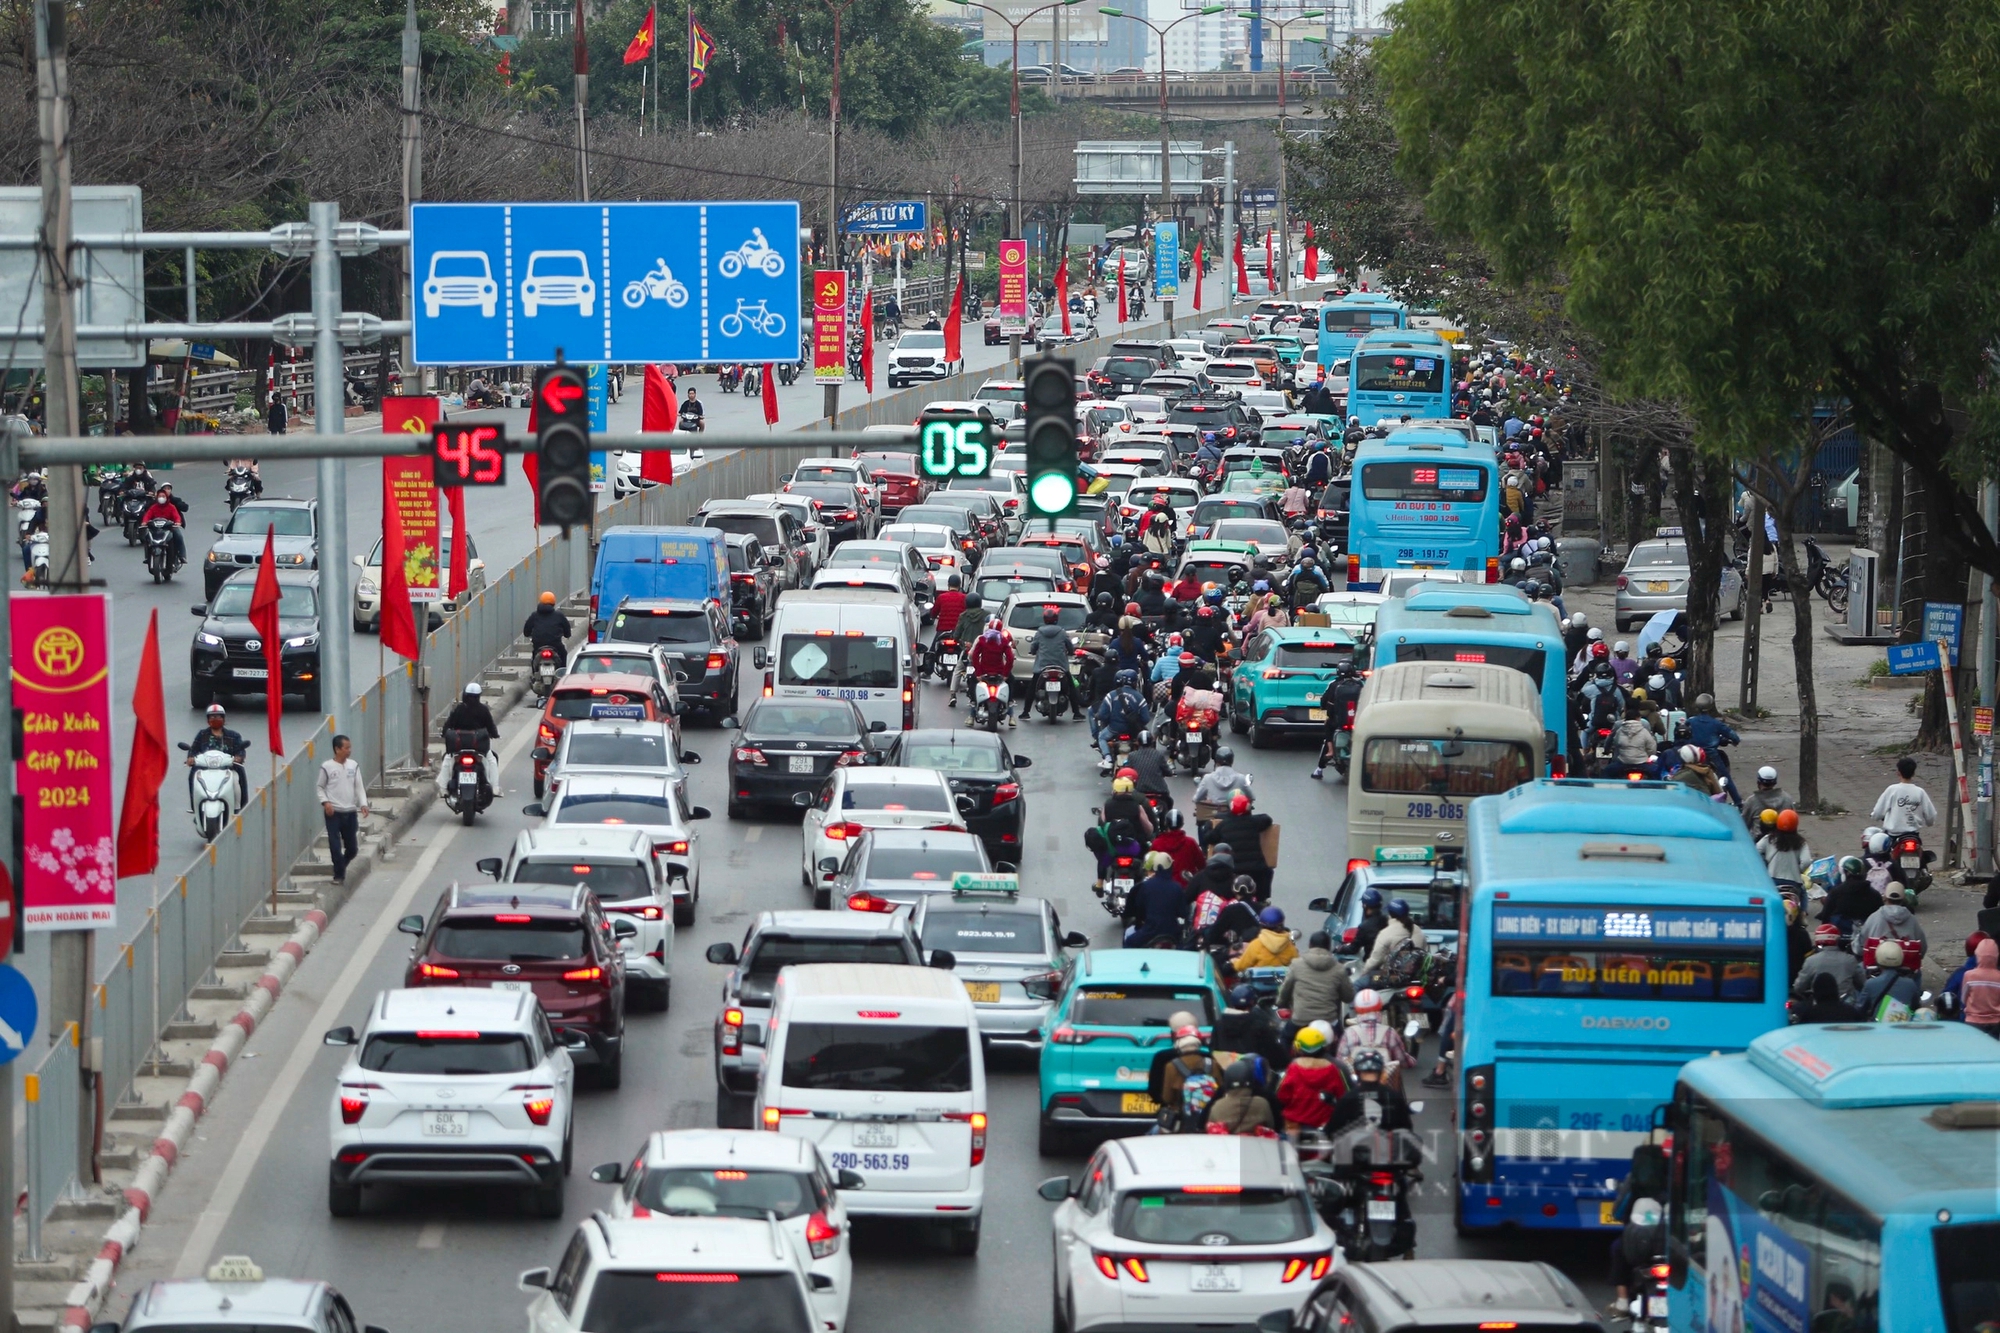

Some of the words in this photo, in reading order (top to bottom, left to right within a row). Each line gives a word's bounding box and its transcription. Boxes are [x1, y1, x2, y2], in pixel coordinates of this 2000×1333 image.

[899, 204, 915, 221] KỲ
[436, 427, 501, 482] 45
[923, 421, 987, 476] 05
[1398, 549, 1413, 558] 29B
[1422, 549, 1449, 558] 191.57
[839, 690, 868, 700] 030.98
[24, 711, 59, 734] Chào
[38, 786, 90, 808] 2024
[27, 912, 53, 924] QUẬN
[92, 910, 111, 920] MAI
[1497, 916, 1519, 934] LONG
[1520, 914, 1541, 934] BIÊN
[1561, 967, 1597, 984] BUS
[1602, 964, 1641, 984] LIÊN
[1580, 1016, 1671, 1032] DAEWOO
[436, 1113, 455, 1124] 60K
[1570, 1112, 1604, 1131] 29F
[429, 1124, 464, 1134] 196.23
[857, 1135, 893, 1146] 563.59
[832, 1152, 910, 1170] 29D-563.59
[220, 1267, 253, 1278] TAXI
